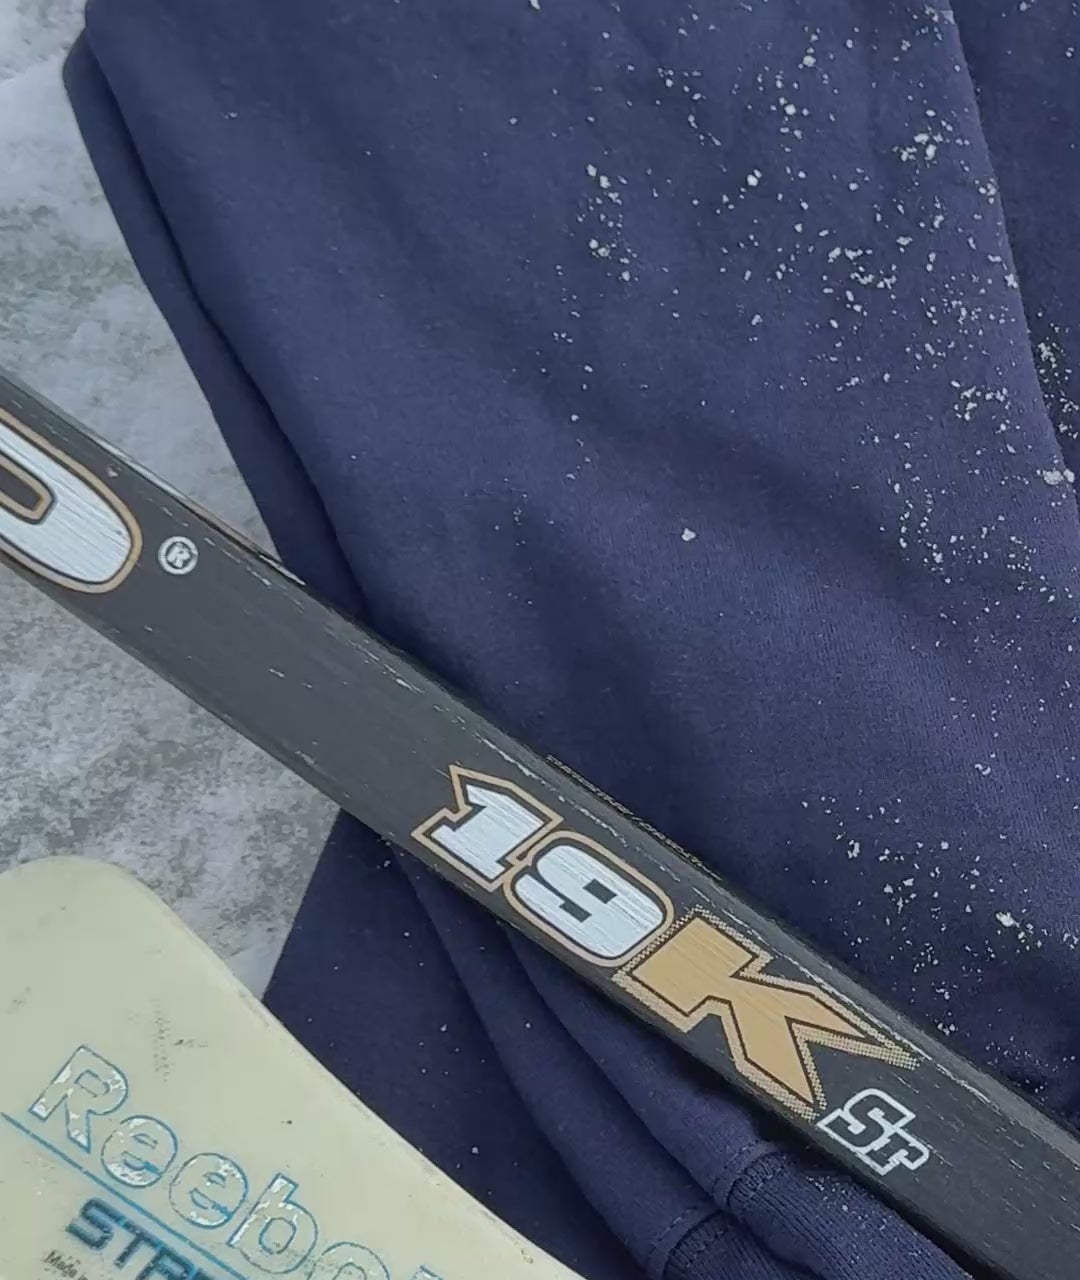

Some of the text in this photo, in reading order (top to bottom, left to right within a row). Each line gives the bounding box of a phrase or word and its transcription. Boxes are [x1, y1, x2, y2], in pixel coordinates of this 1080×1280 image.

[410, 764, 931, 1176] 19K Sr
[44, 1250, 78, 1279] Made
